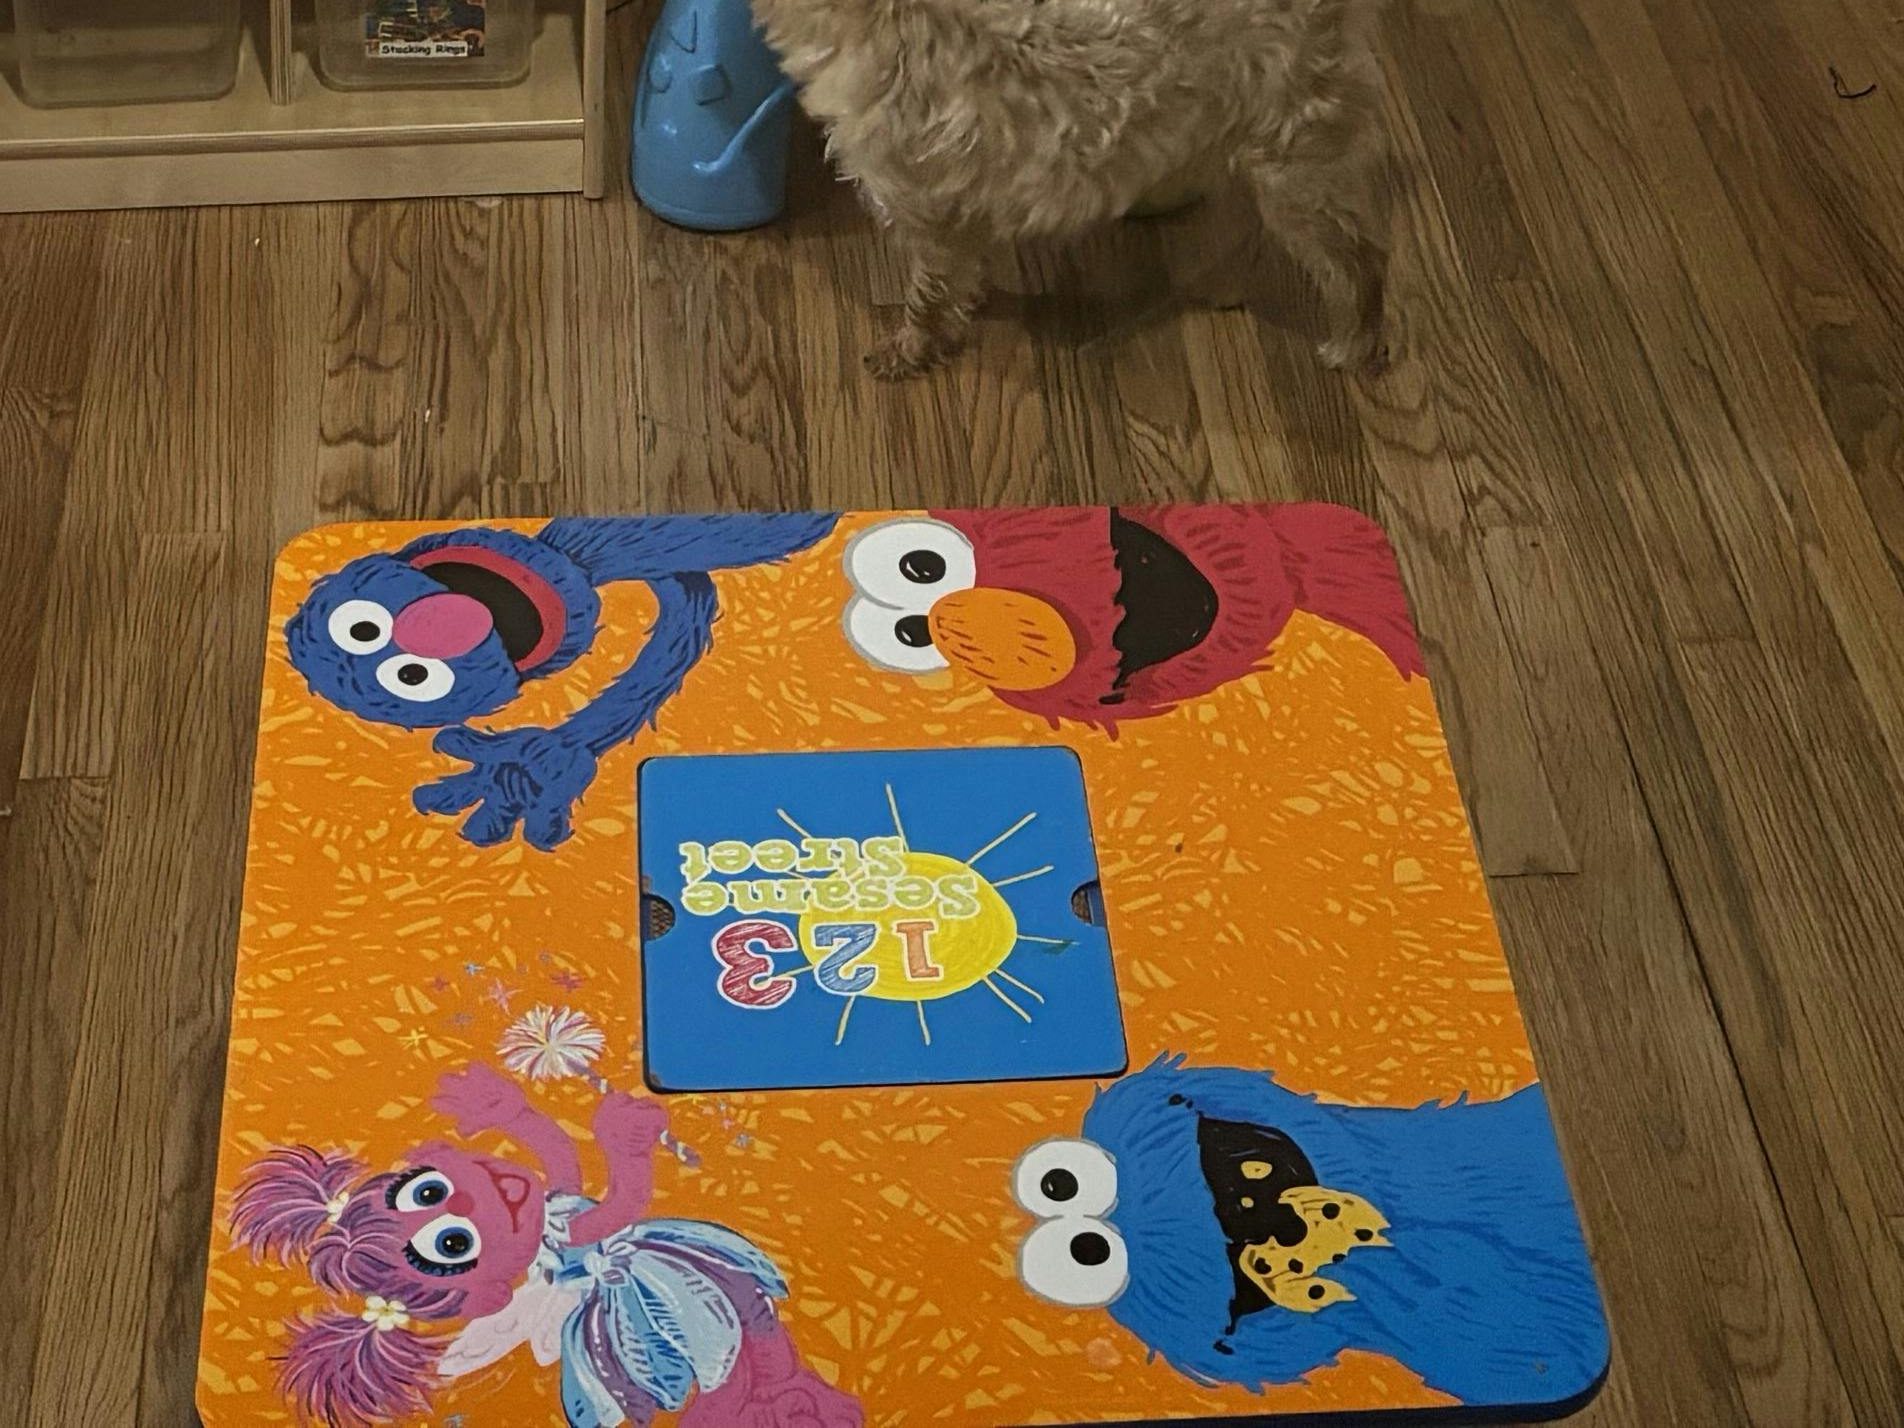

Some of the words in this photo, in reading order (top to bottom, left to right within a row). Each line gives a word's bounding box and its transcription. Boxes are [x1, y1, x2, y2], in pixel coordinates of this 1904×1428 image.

[381, 45, 432, 56] Stacking
[436, 45, 466, 55] Rings
[680, 836, 906, 876] Street
[682, 873, 980, 919] Sesame
